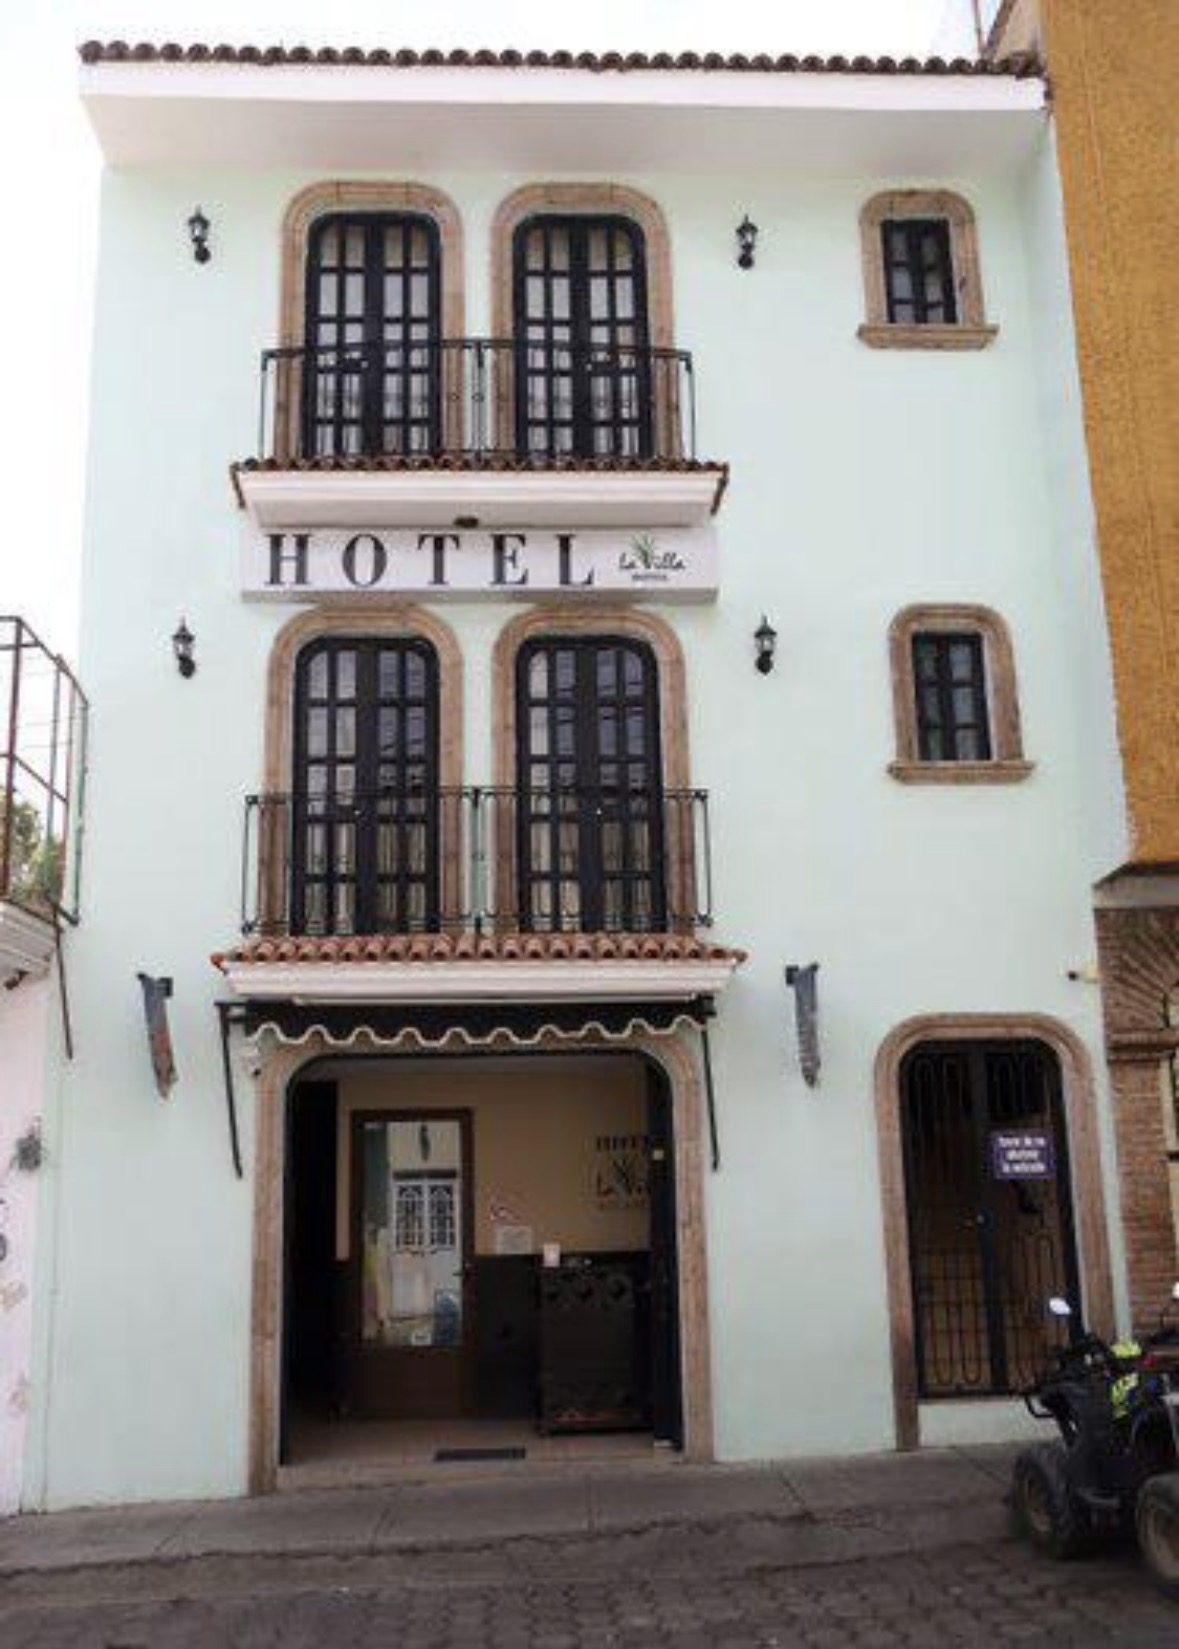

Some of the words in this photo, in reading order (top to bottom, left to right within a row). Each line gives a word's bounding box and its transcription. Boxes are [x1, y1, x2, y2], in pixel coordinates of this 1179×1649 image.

[265, 533, 594, 586] HOTEL
[619, 552, 636, 569] La
[638, 545, 686, 570] Villa
